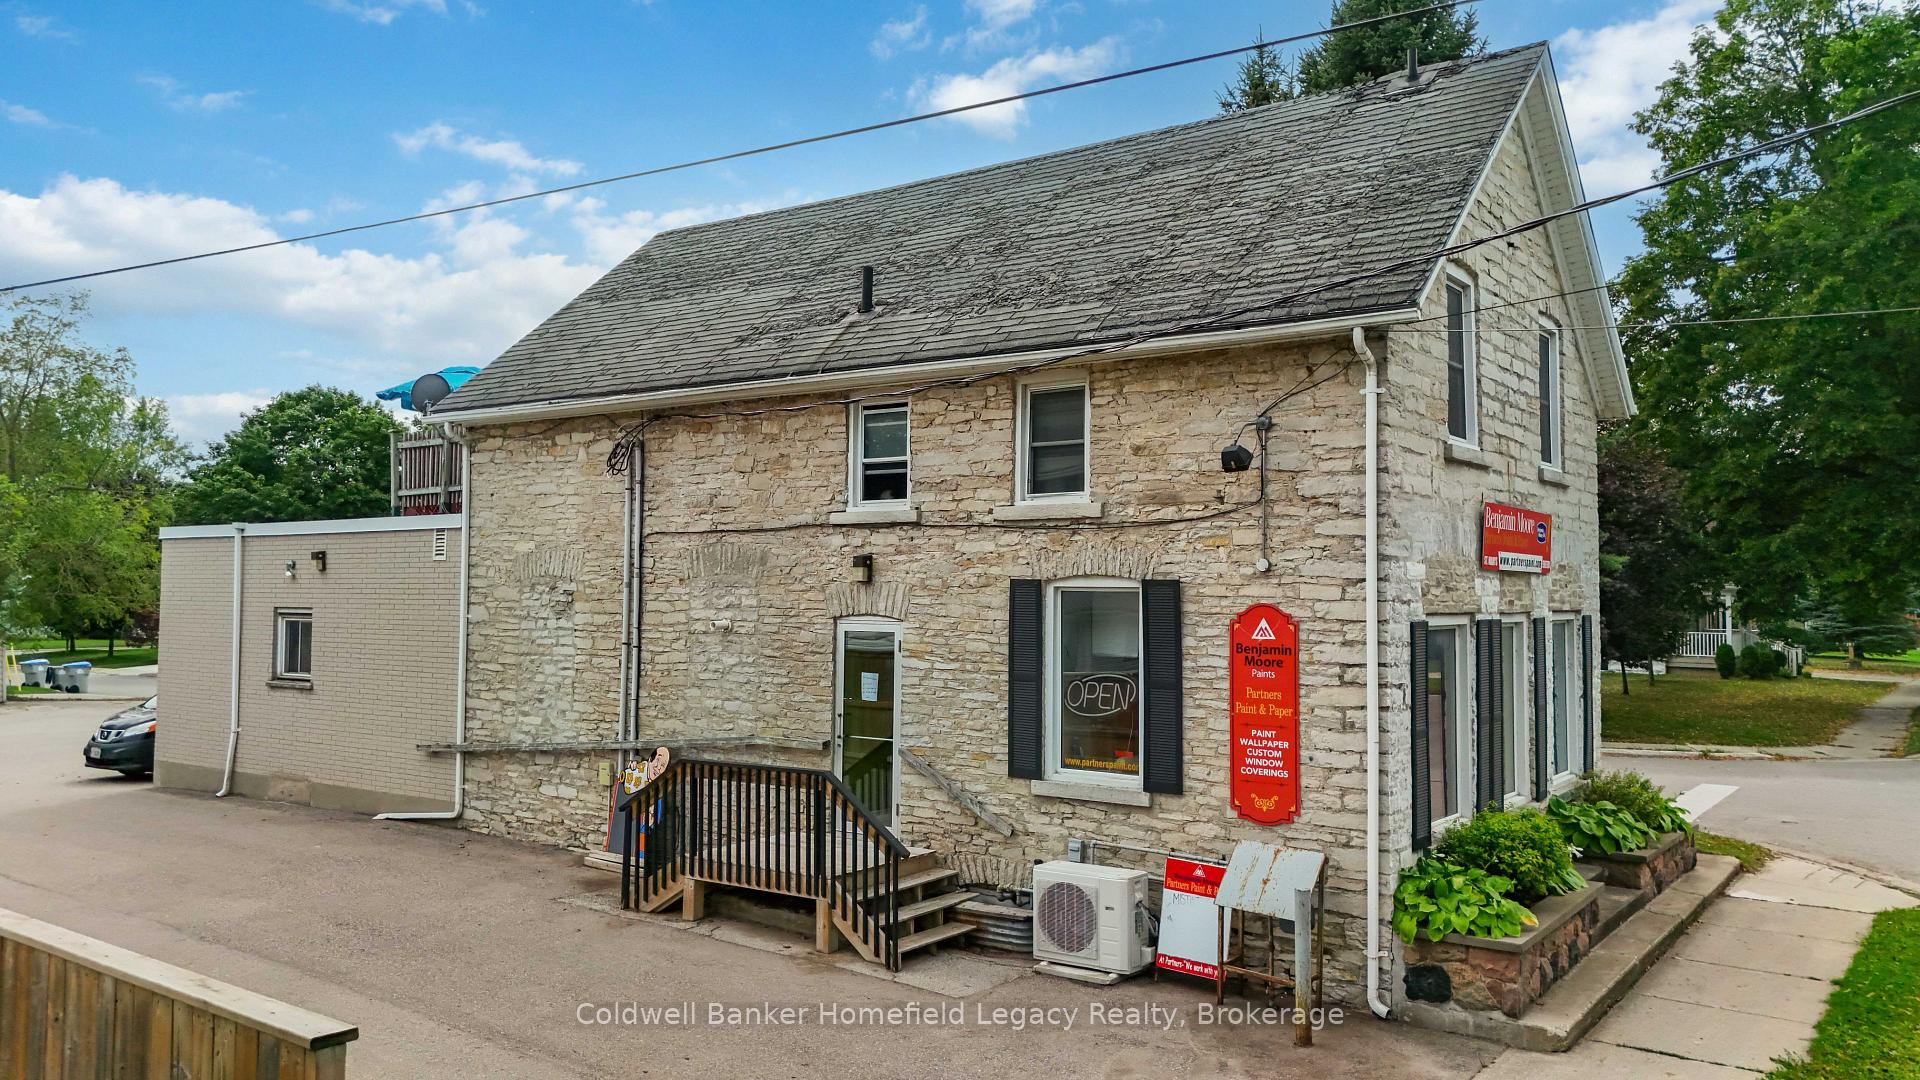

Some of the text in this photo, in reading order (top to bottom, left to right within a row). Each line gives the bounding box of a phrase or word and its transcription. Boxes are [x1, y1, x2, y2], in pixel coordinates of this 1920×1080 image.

[1485, 506, 1516, 533] Benjamin
[1517, 512, 1535, 534] Moore
[1236, 642, 1292, 657] Benjamin
[1244, 655, 1283, 668] Moore
[1251, 668, 1275, 679] Paints
[1067, 680, 1131, 710] OPEN
[1246, 686, 1282, 700] Partners
[1235, 701, 1293, 719] Paint & Paper
[1251, 729, 1276, 738] PAINT
[1240, 737, 1289, 749] WALLPAPER
[1246, 748, 1282, 758] CUSTOM
[1245, 757, 1284, 767] WINDOW
[1240, 766, 1289, 778] COVERINGS
[1166, 877, 1190, 892] Partners
[1191, 881, 1206, 894] Paint
[1206, 885, 1213, 895] &
